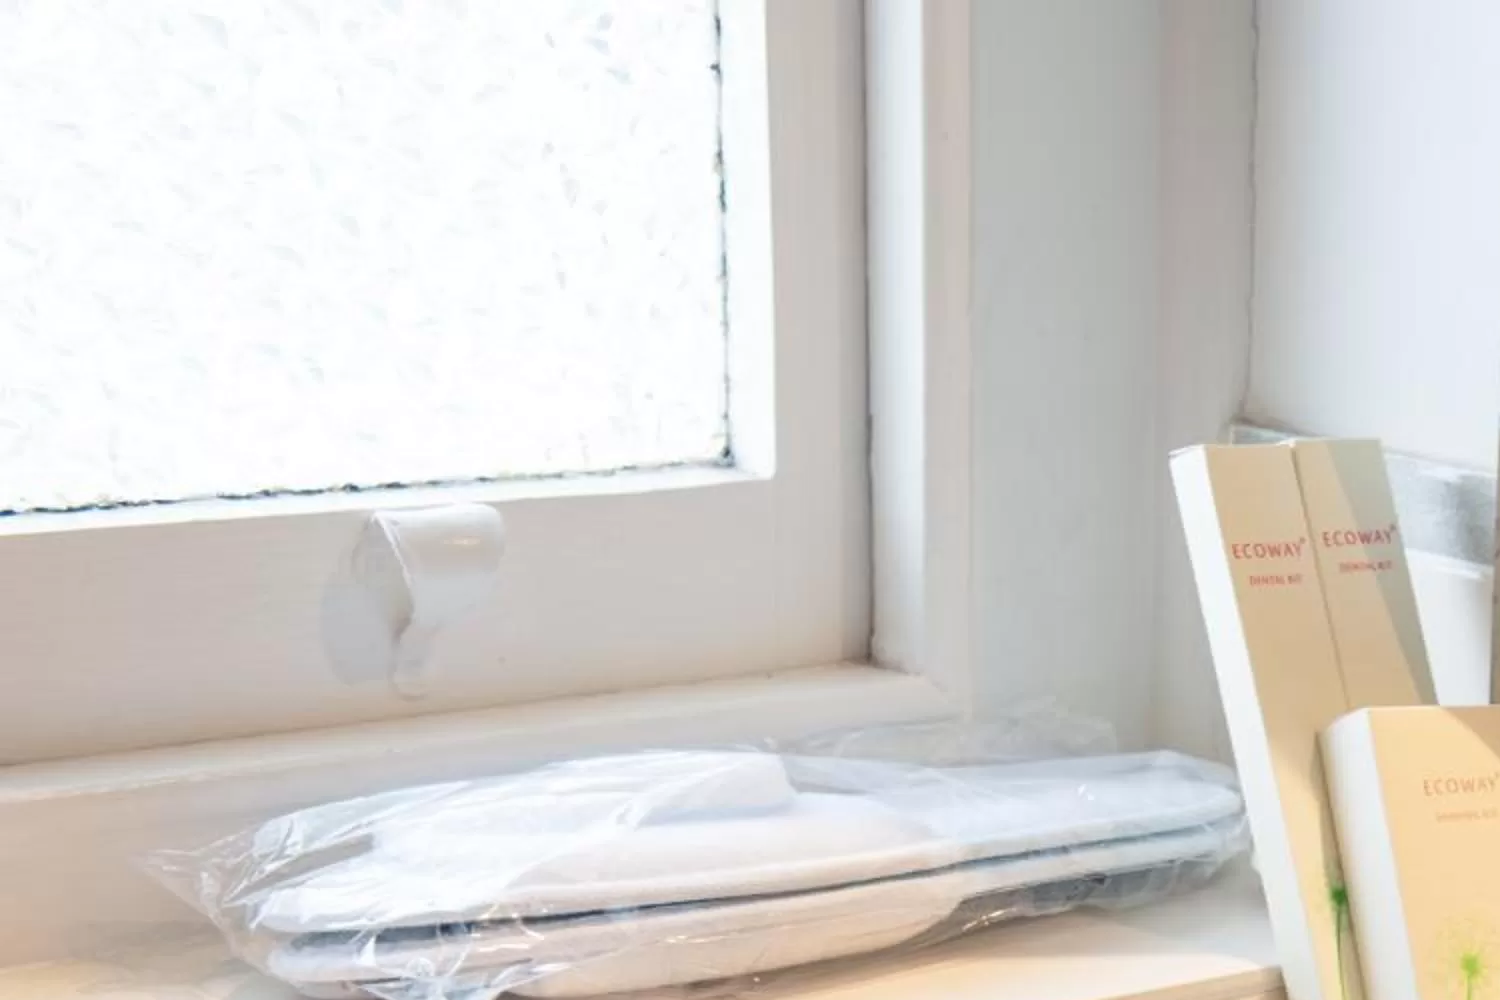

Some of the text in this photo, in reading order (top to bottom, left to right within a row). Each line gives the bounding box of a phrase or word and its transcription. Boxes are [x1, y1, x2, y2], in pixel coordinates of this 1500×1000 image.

[1322, 529, 1392, 548] ECOWAY
[1231, 542, 1303, 559] ECOWAY
[1423, 776, 1497, 797] ECOWAY
